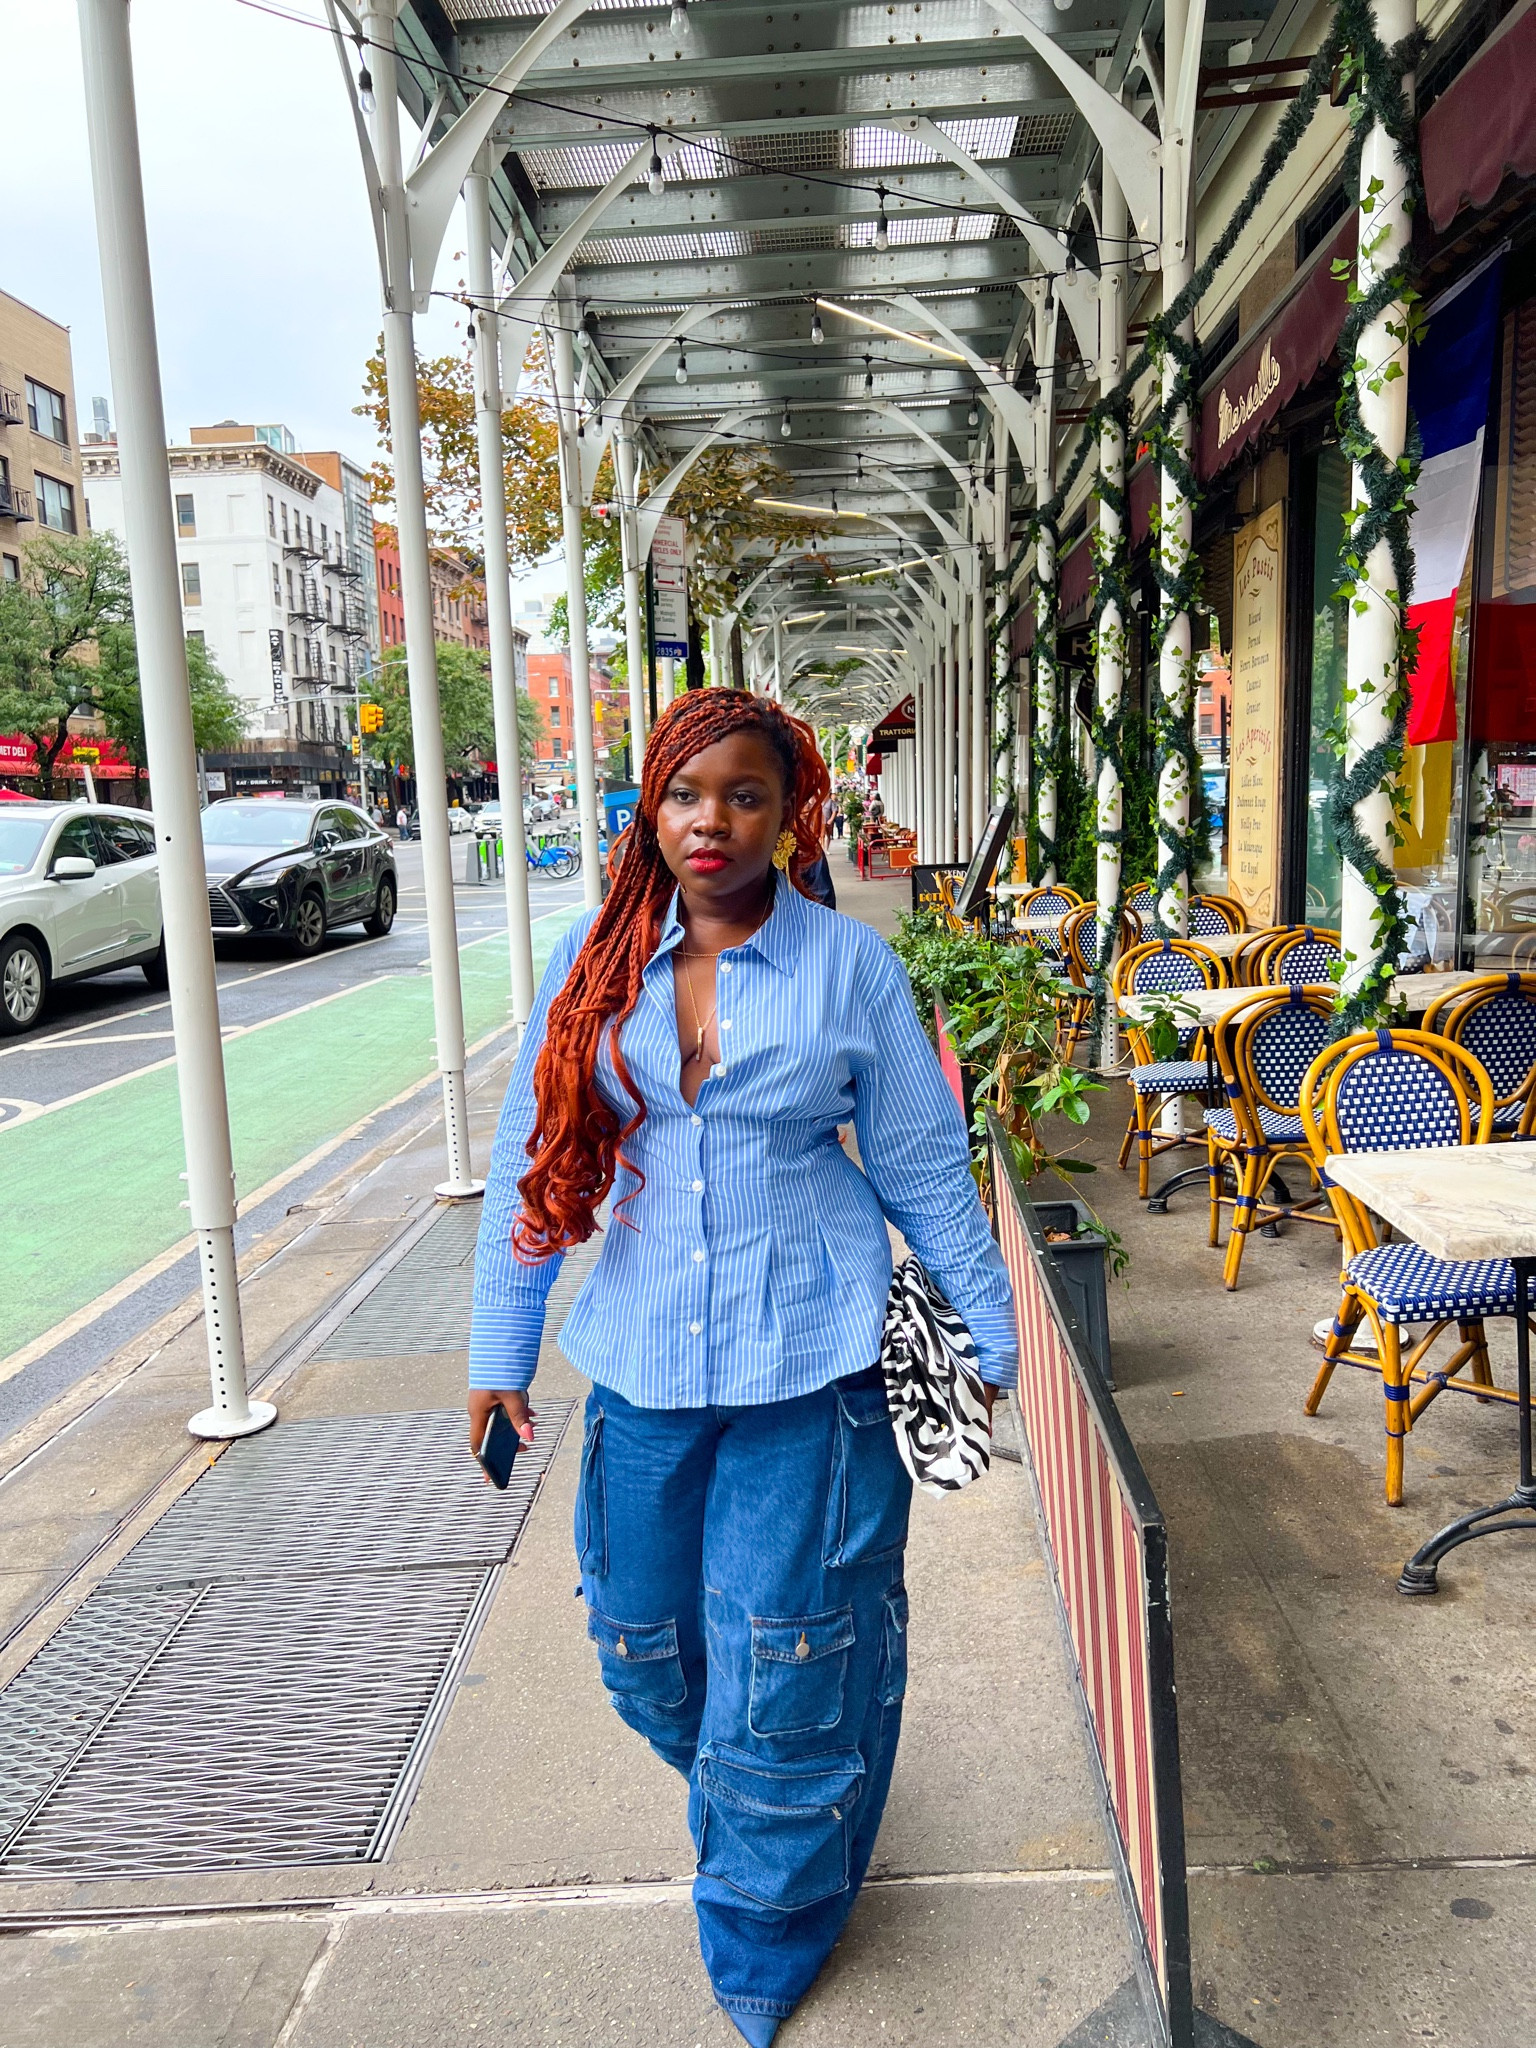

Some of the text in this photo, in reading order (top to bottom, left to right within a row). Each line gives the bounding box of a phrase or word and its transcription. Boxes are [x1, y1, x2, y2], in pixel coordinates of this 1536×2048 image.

[653, 537, 679, 548] MMERCIAL
[652, 547, 669, 555] HICLES
[1238, 557, 1274, 598] Les Pastis
[1071, 636, 1089, 656] R
[907, 705, 914, 714] N
[12, 746, 27, 757] DELI
[616, 809, 631, 832] P
